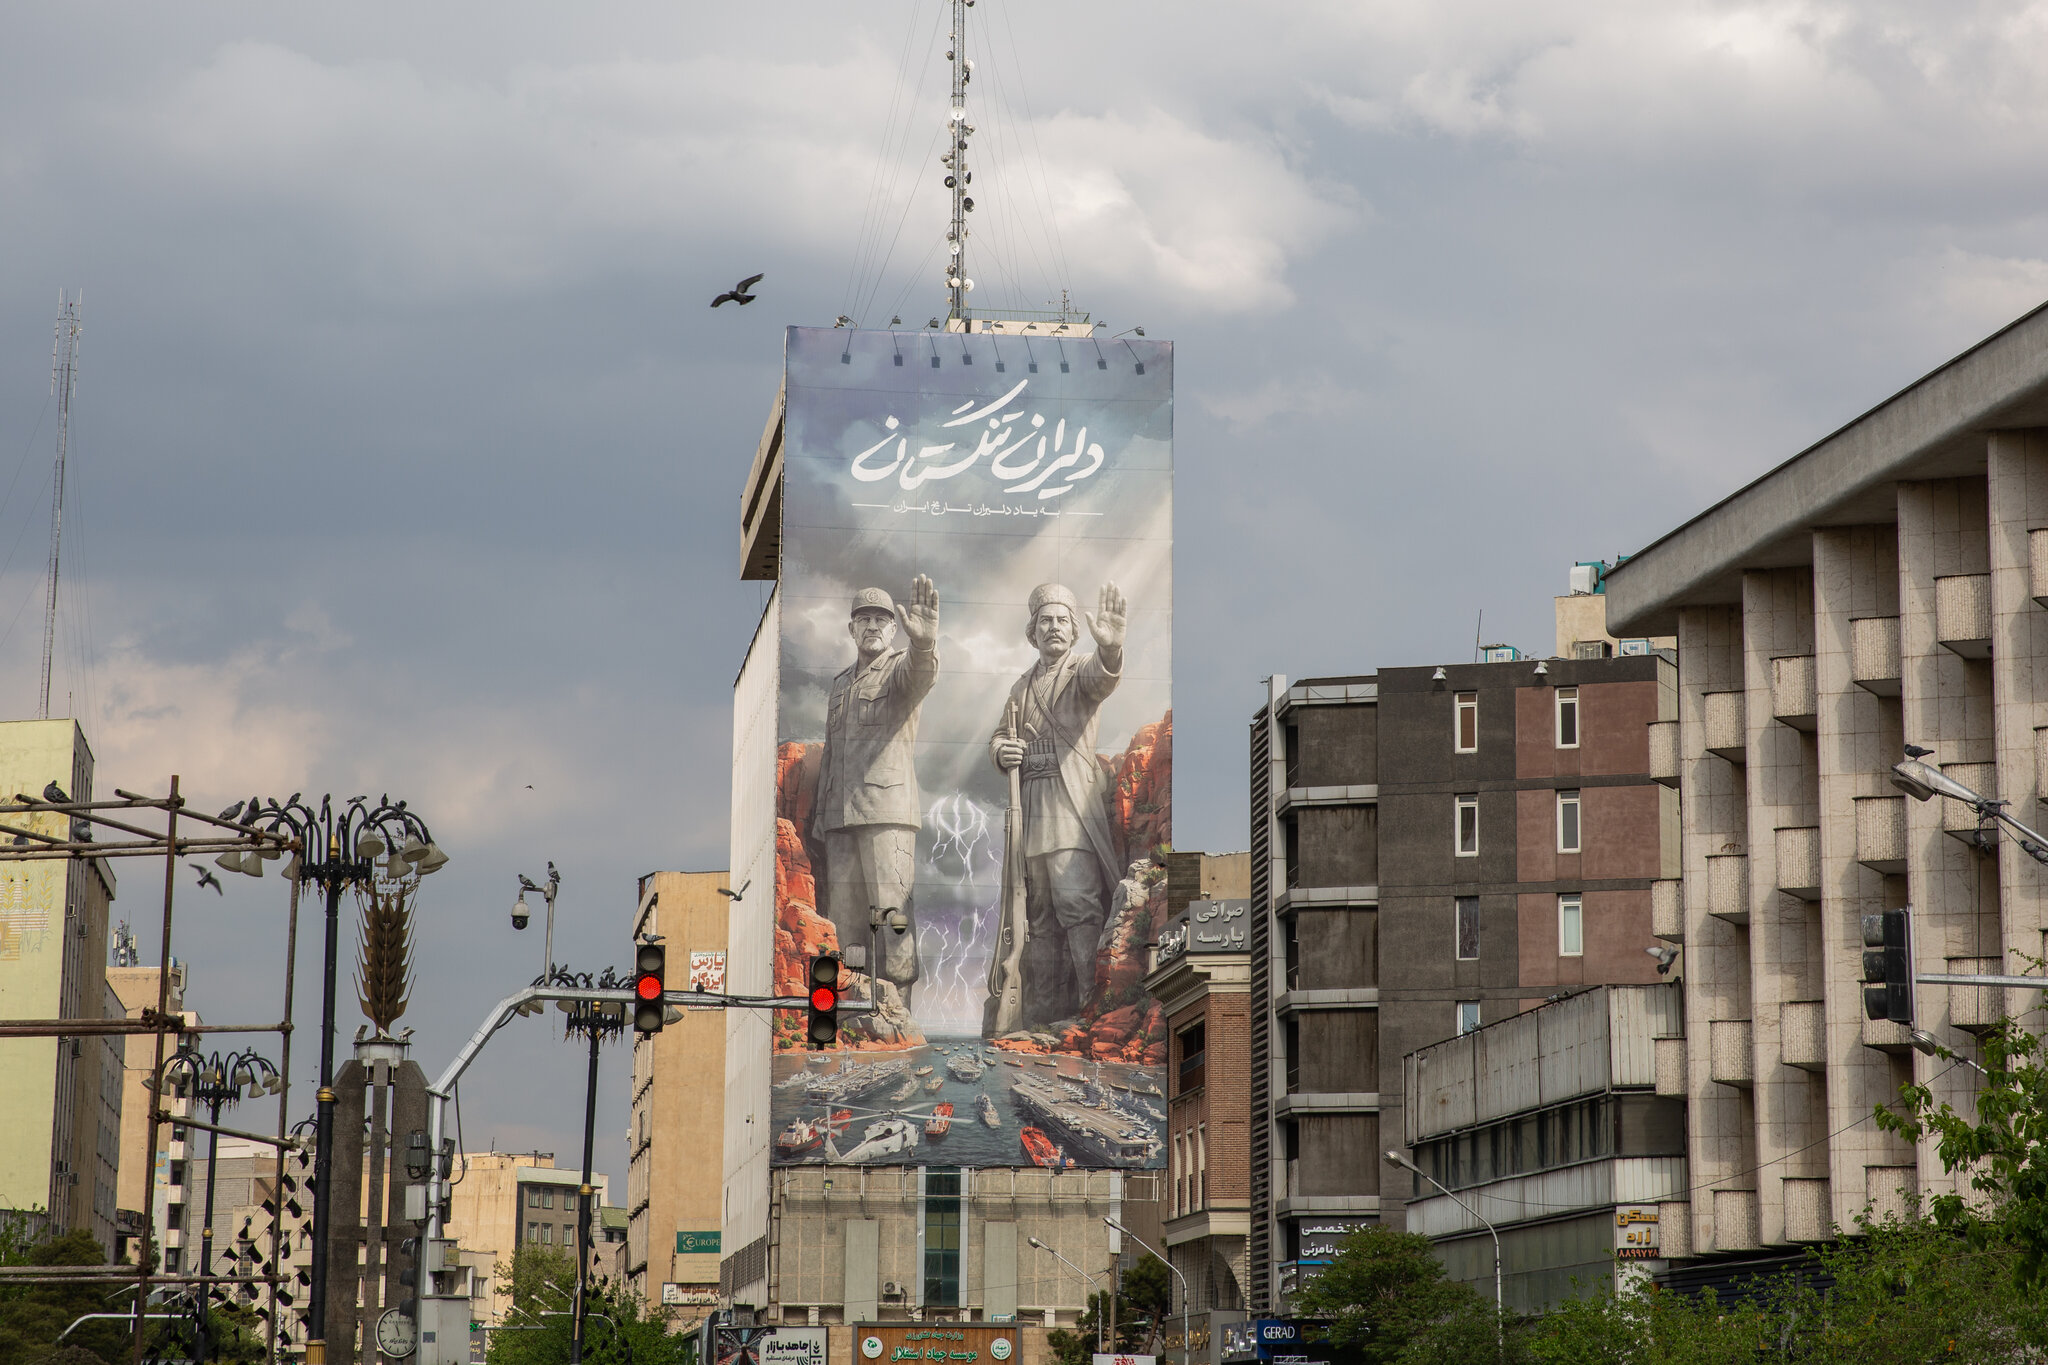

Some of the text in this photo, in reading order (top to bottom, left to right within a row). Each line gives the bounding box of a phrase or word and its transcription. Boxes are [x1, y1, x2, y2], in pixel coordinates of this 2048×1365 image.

[850, 378, 1105, 500] دلیران تنگستان
[893, 500, 1061, 518] به یاد دلیران تاریخ ایران
[1196, 901, 1244, 923] صرافی
[1196, 926, 1245, 949] پارسه
[691, 952, 725, 971] پارس
[691, 972, 725, 990] ایزوگام
[1626, 1227, 1651, 1243] زرد
[1301, 1242, 1334, 1257] نامرئی
[905, 1331, 964, 1341] وزارت جهاد کشاورزی
[1263, 1326, 1296, 1340] GERAD
[766, 1340, 809, 1354] جاهد بازار
[891, 1346, 978, 1364] موسسه جهاد استقلال
